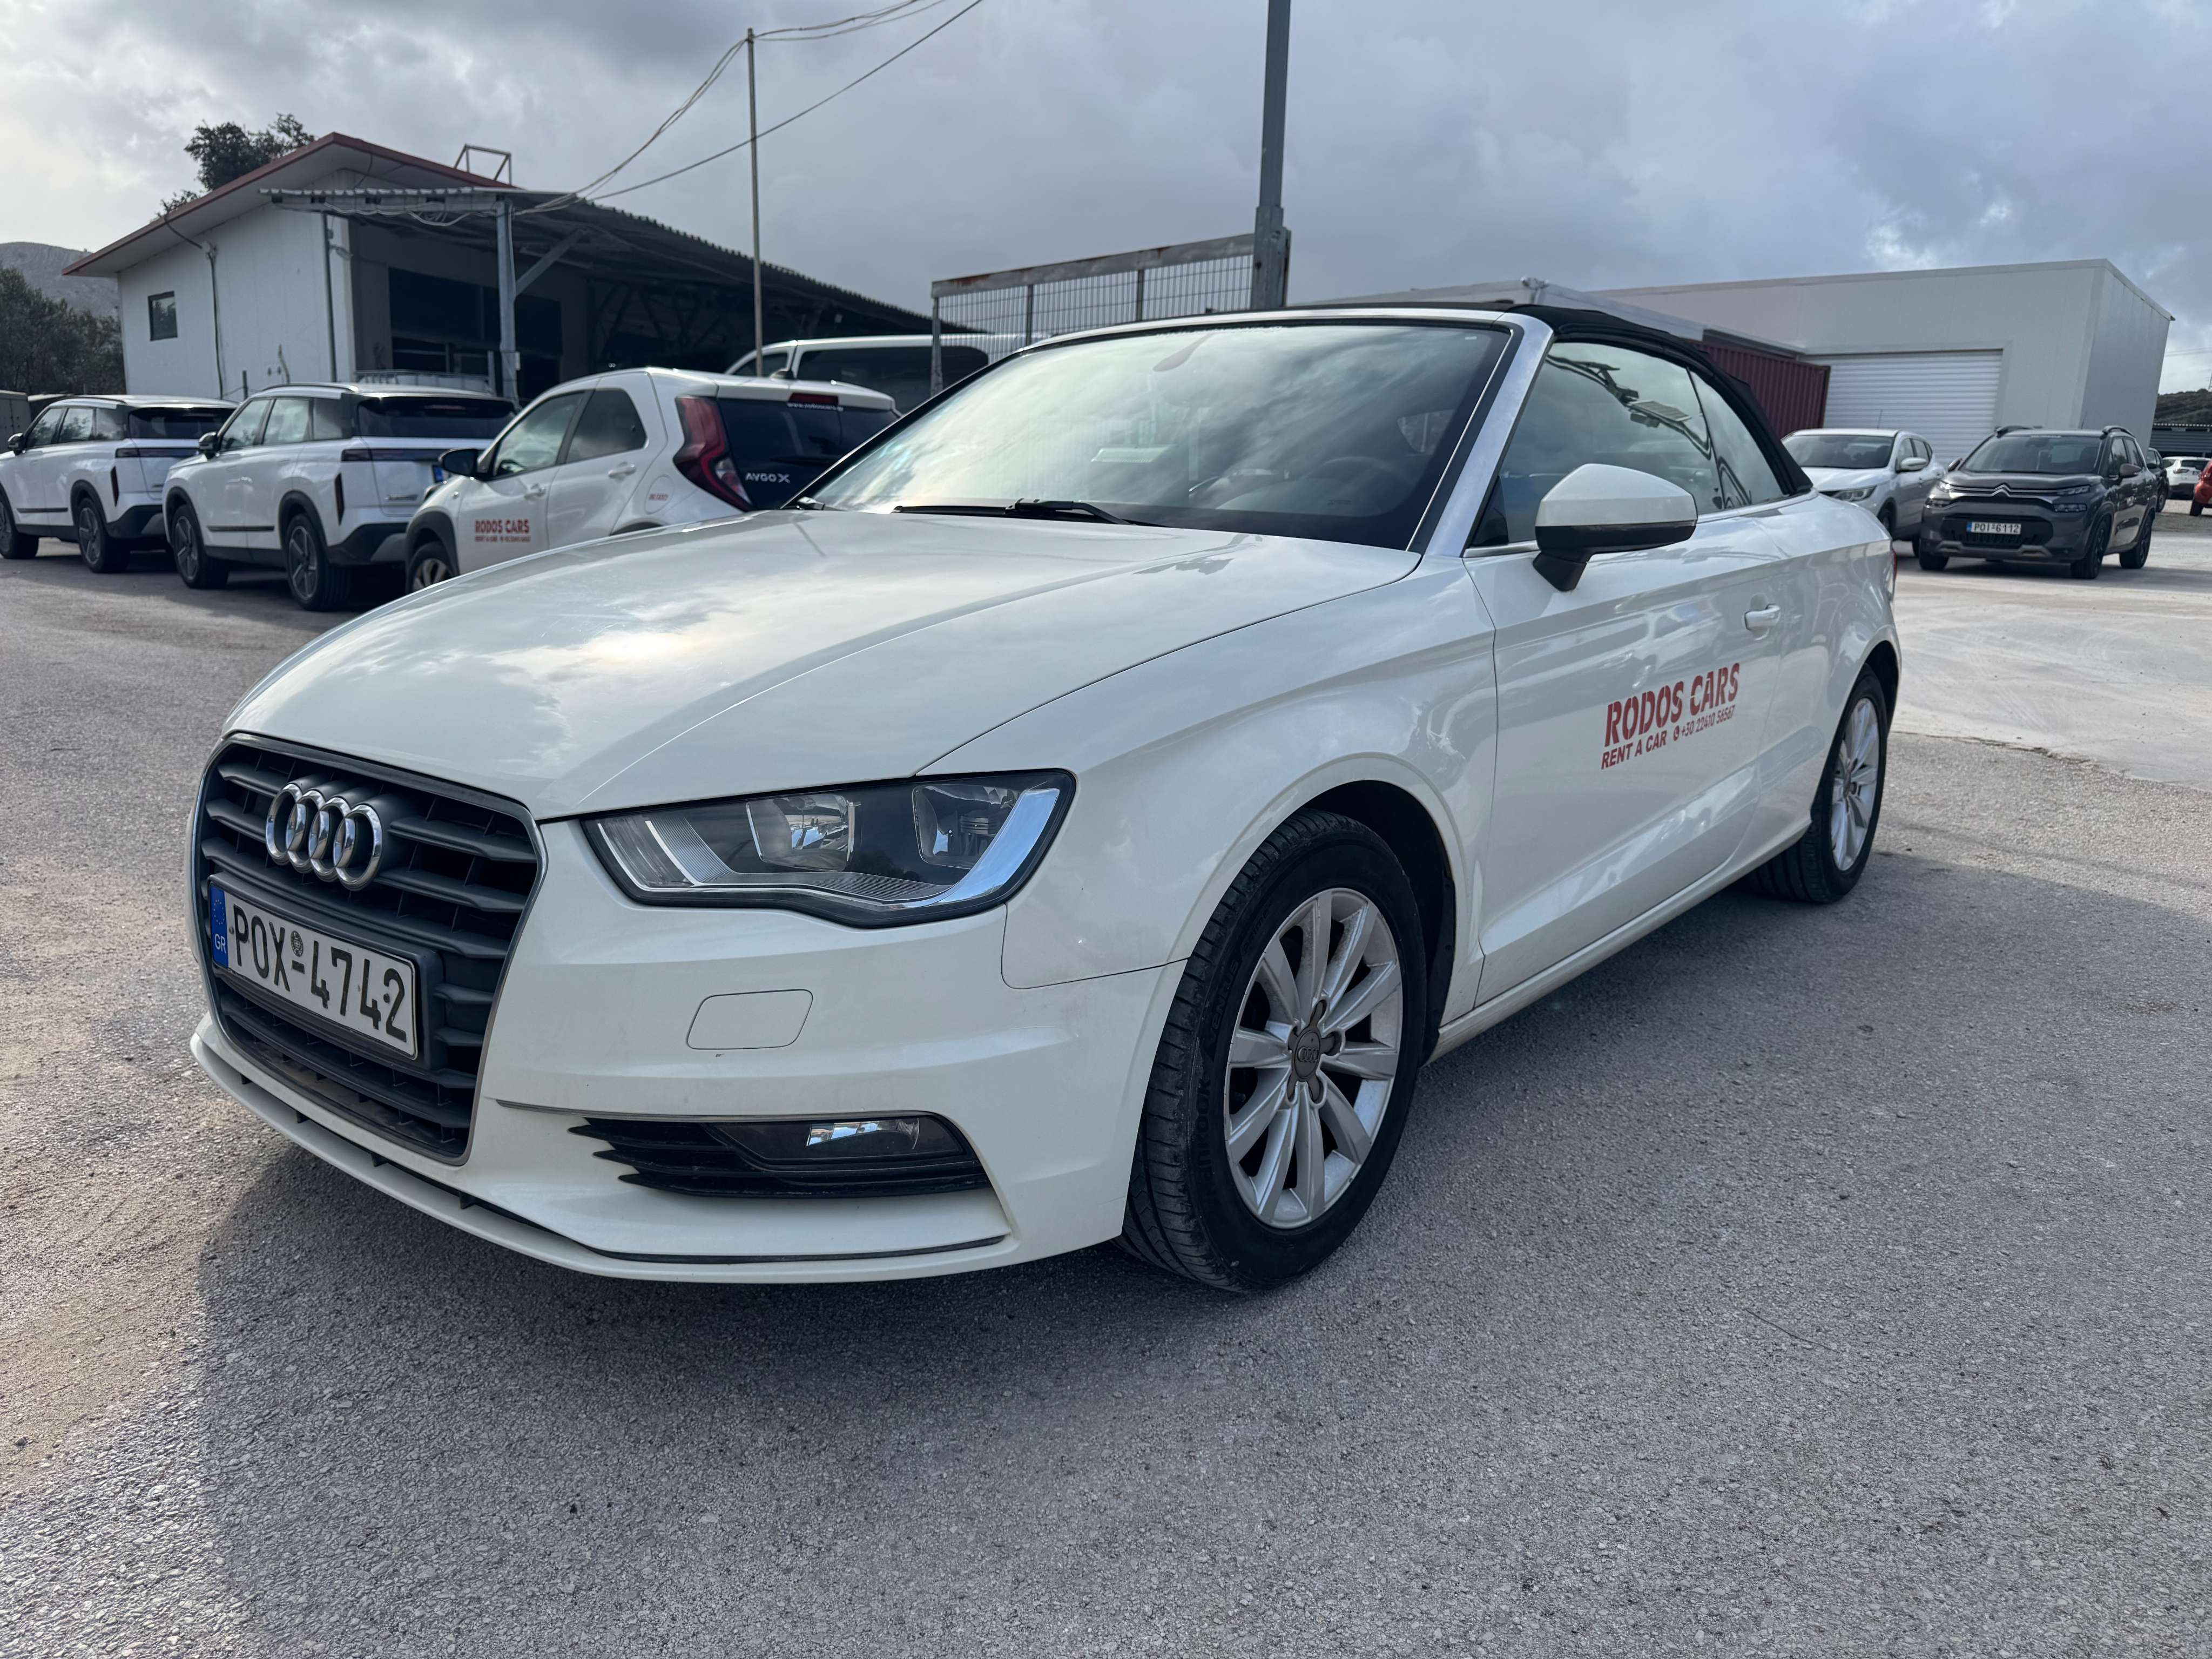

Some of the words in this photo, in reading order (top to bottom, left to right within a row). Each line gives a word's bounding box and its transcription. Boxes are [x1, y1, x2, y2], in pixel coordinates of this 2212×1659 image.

[745, 472, 777, 482] AYGO
[475, 520, 503, 534] RODOS
[505, 519, 530, 534] CARS
[1604, 680, 1684, 747] RODOS
[1689, 663, 1740, 716] CARS
[1601, 742, 1633, 770] RENT
[1634, 739, 1642, 757] A
[1645, 730, 1667, 752] CAR
[1681, 720, 1695, 737] +30
[214, 933, 227, 954] GR
[233, 903, 407, 1043] POX-4742
